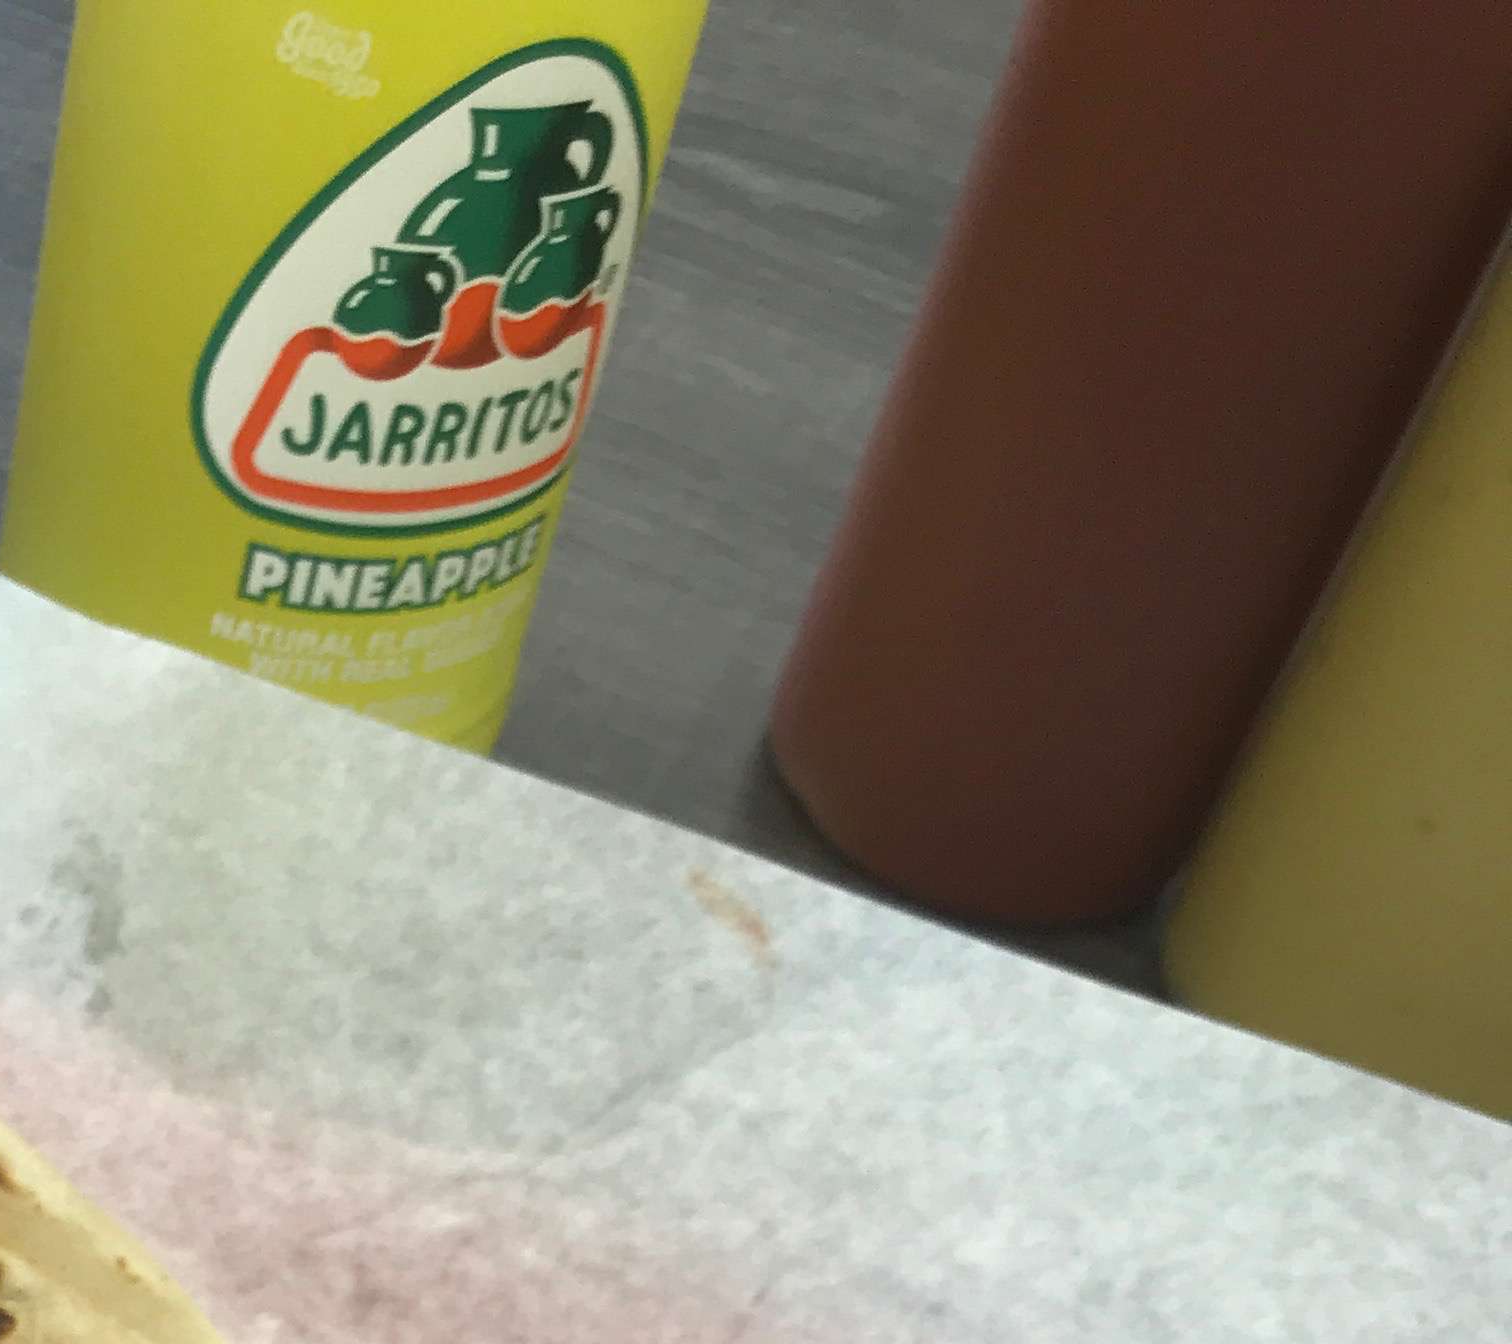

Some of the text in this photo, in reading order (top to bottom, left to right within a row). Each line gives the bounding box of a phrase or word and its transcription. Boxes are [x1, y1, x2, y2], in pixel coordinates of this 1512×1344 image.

[281, 367, 581, 466] JARRITOS
[244, 520, 543, 610] PINEAPPLE
[210, 612, 354, 658] NATURAL
